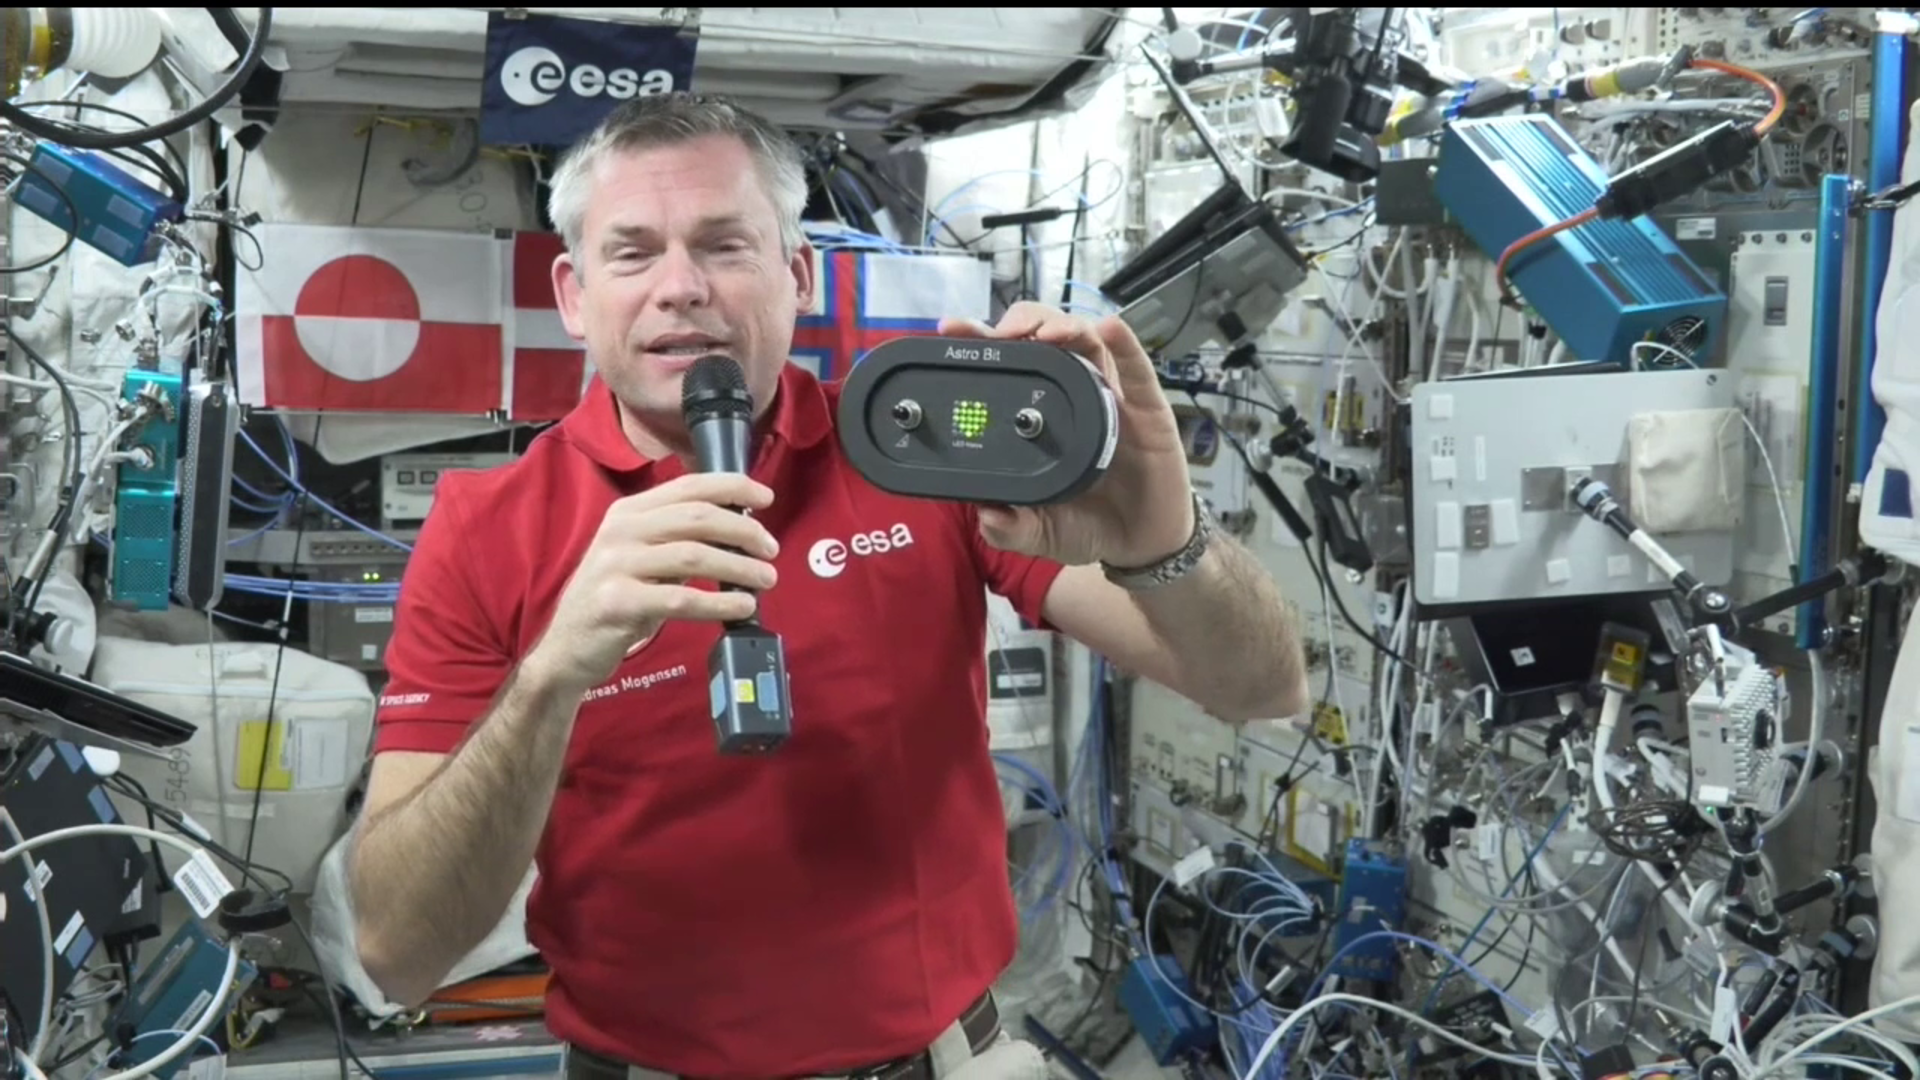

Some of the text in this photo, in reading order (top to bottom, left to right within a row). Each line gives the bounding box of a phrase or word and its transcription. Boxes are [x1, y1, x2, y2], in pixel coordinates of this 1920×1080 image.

[570, 64, 673, 98] esa
[944, 345, 1001, 362] Astro Bit
[851, 523, 914, 555] esa
[580, 664, 687, 701] dreas Mogensen
